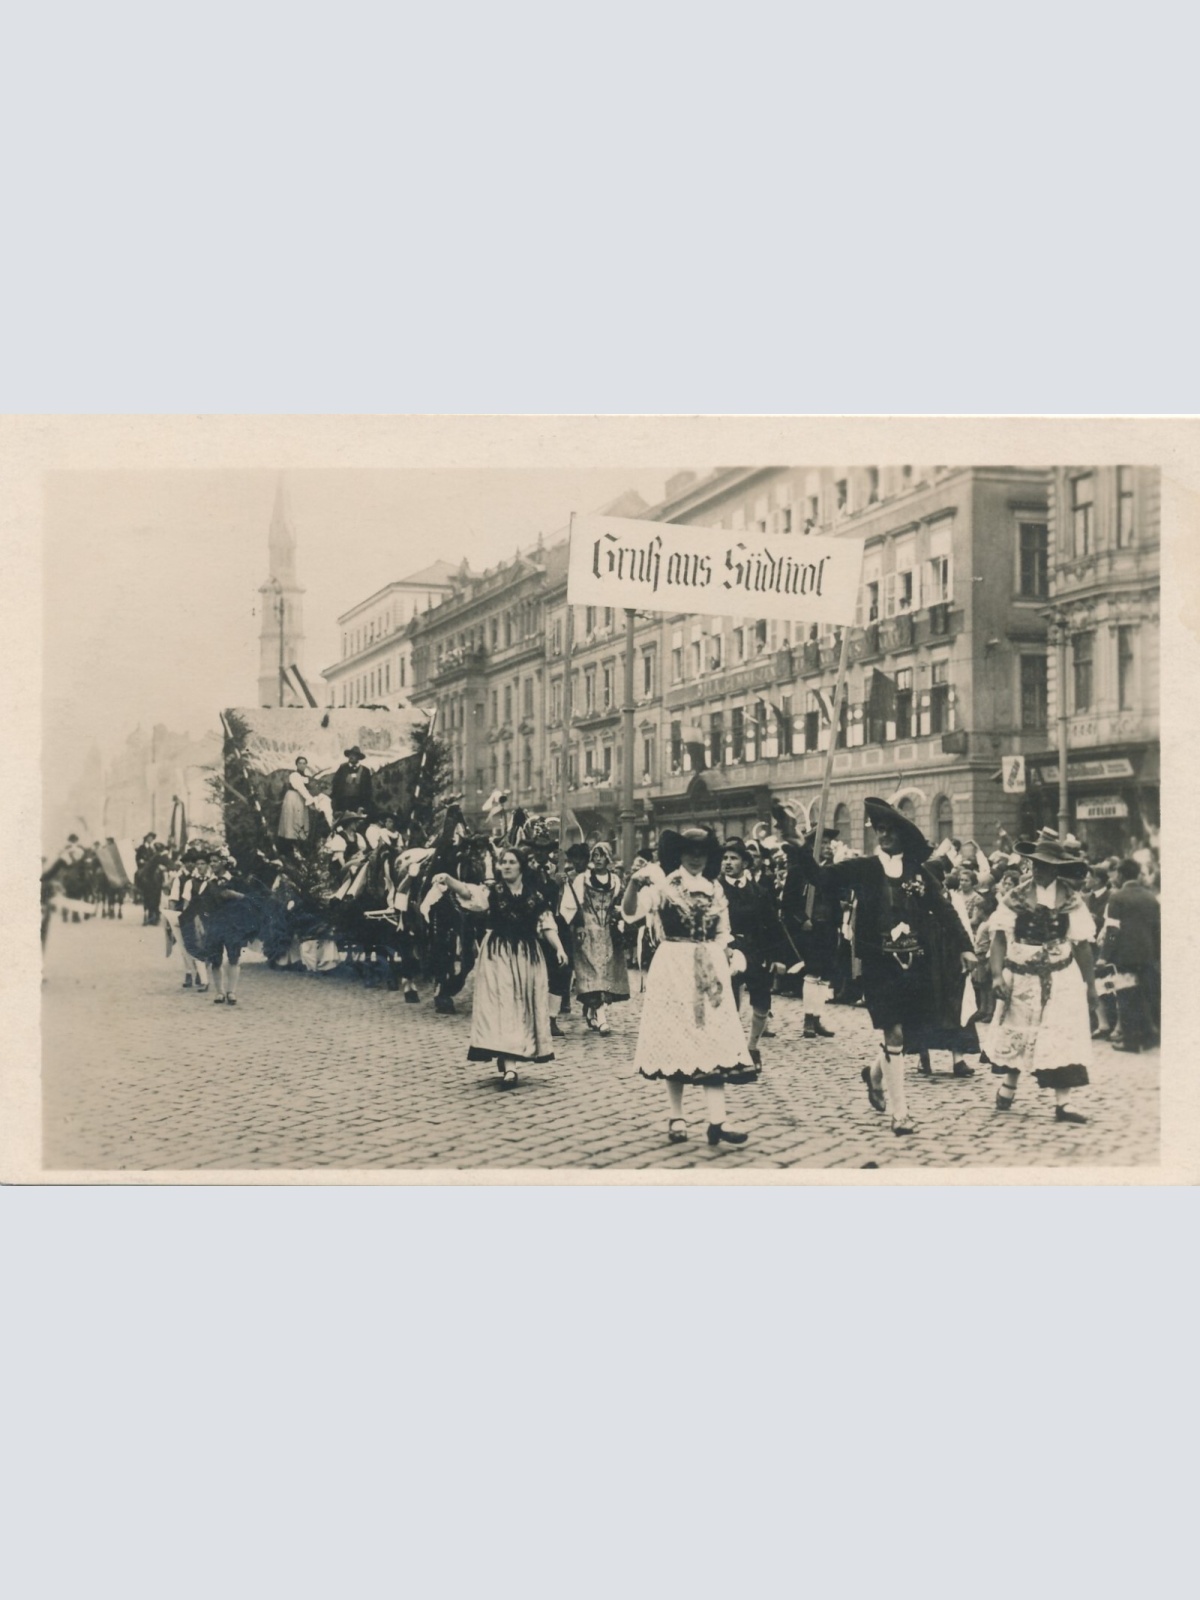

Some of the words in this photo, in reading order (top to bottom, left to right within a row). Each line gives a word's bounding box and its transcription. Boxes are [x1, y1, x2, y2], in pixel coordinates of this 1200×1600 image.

[592, 533, 663, 593] Gruß
[666, 551, 712, 588] aus
[722, 542, 832, 597] Südtirol
